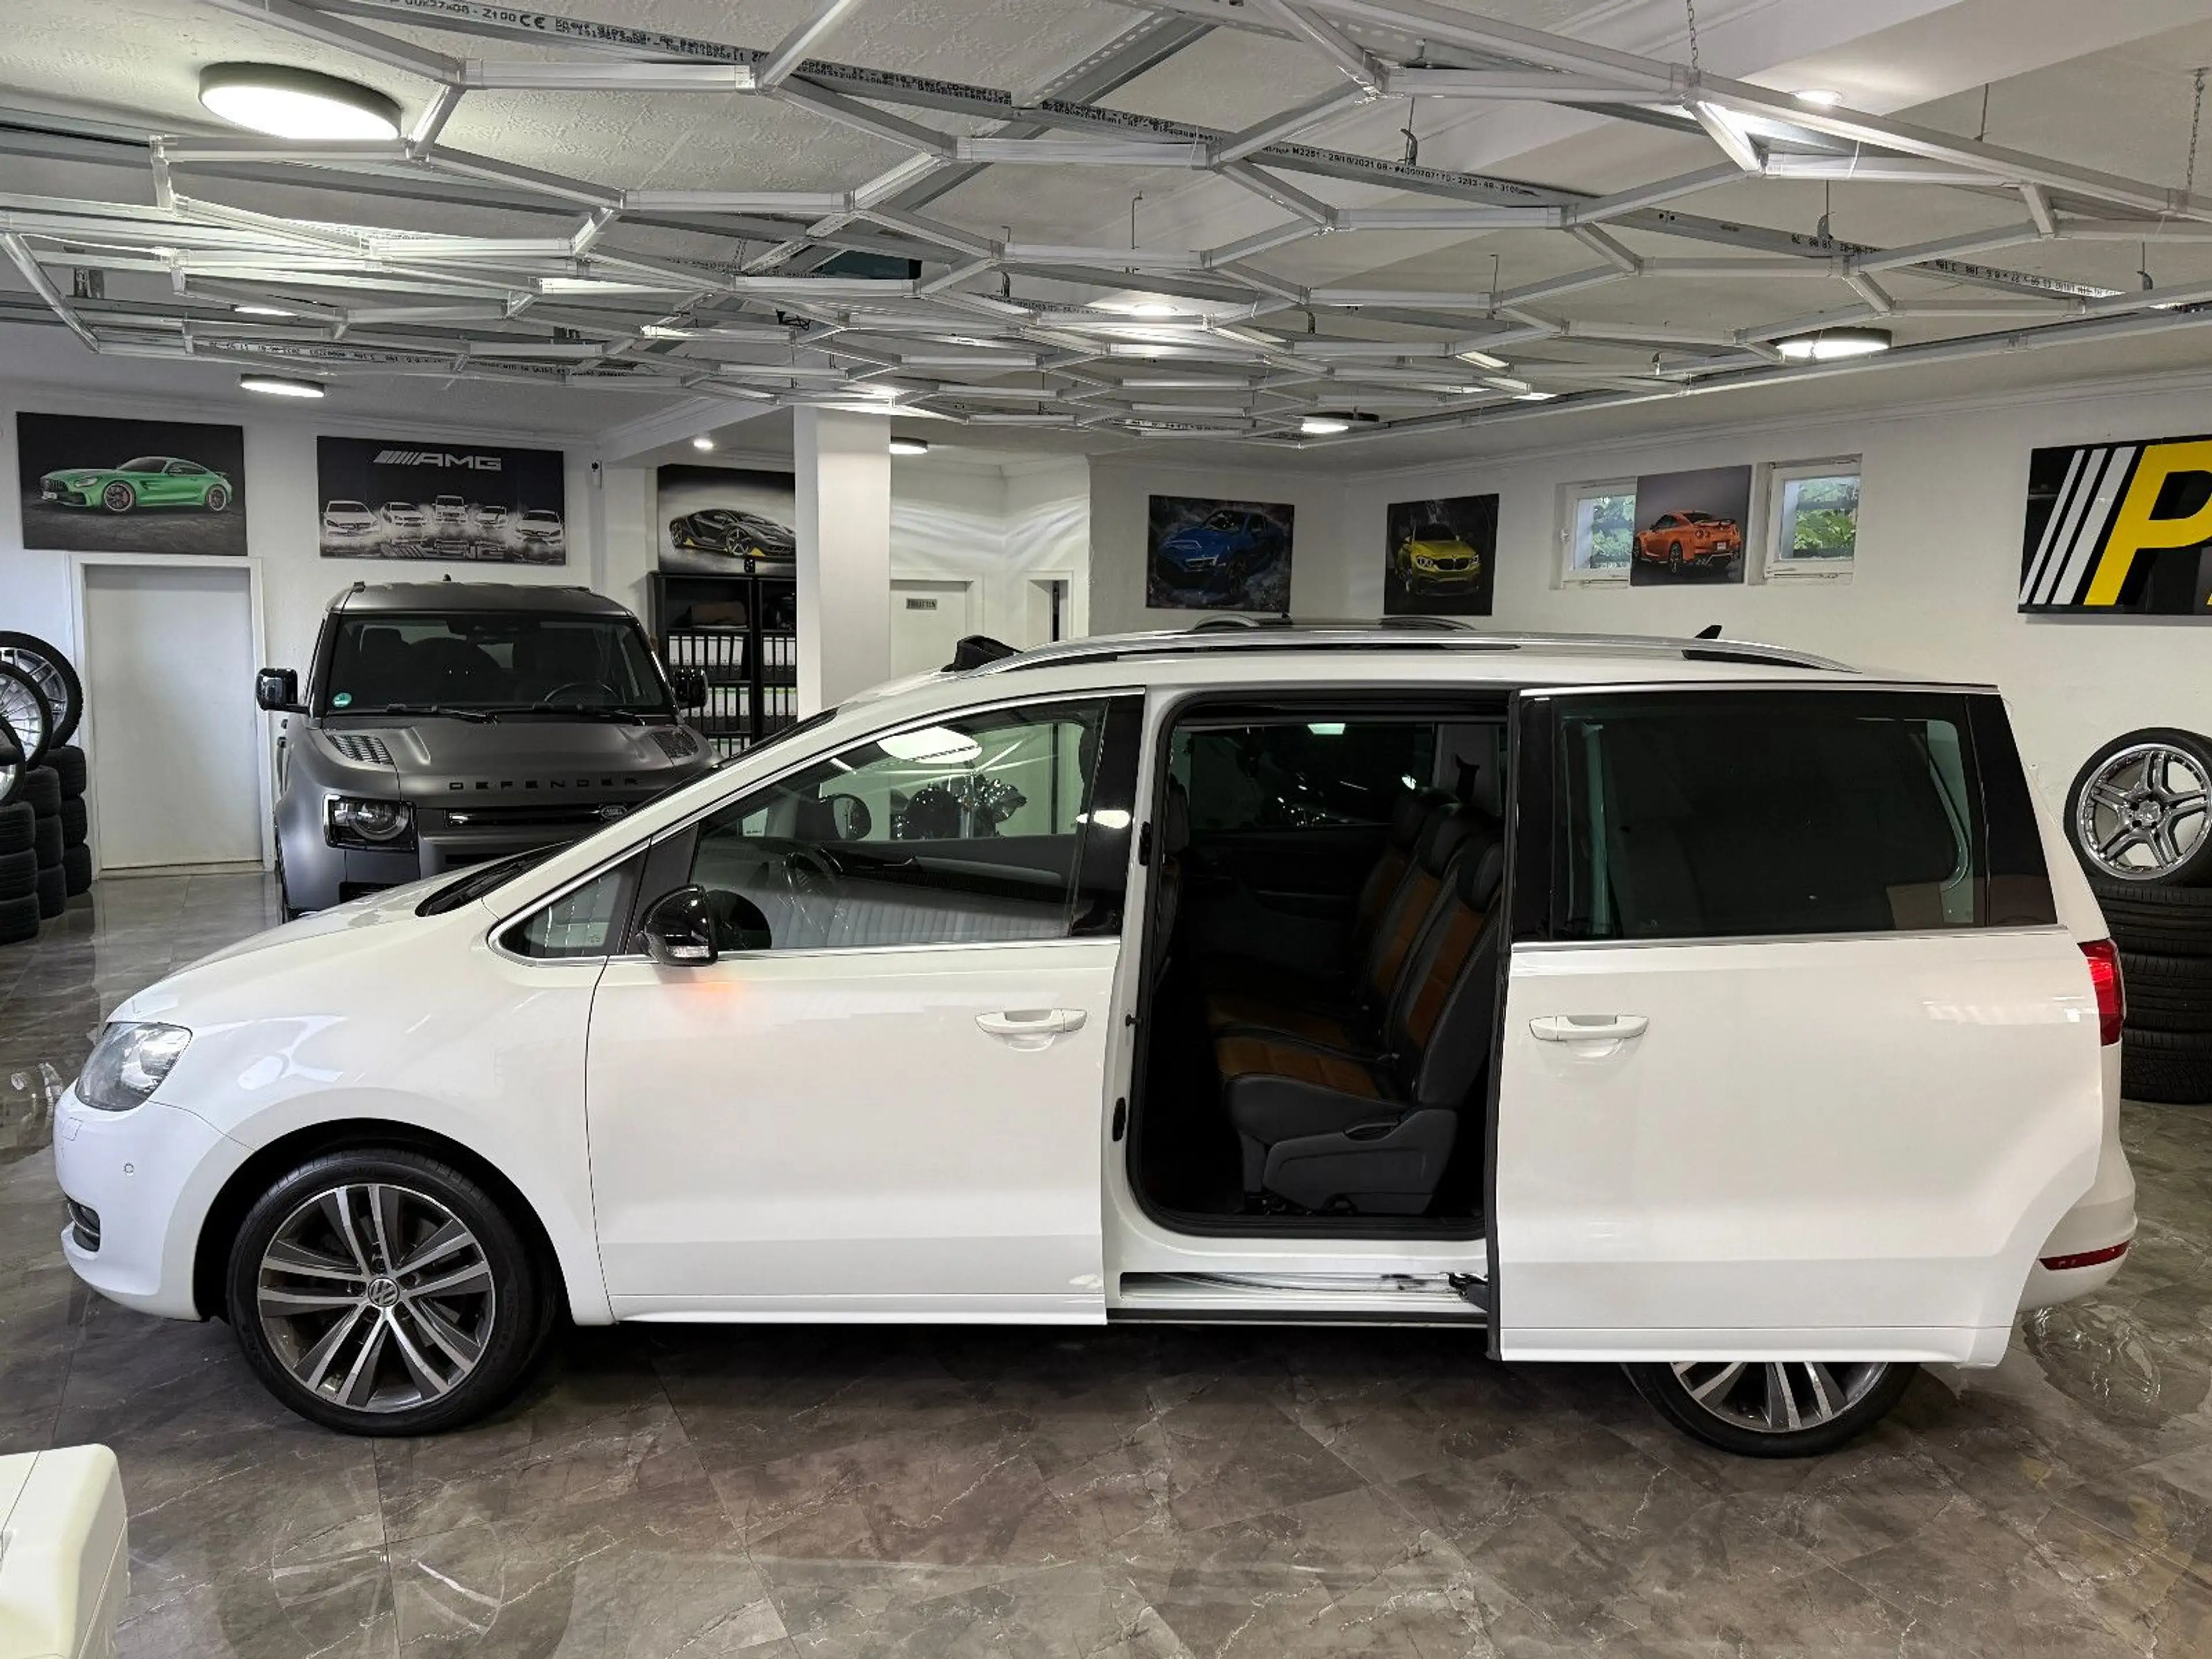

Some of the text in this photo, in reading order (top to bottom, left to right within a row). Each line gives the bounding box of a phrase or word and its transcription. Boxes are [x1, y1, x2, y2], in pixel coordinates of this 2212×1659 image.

[412, 452, 501, 471] AMG
[2083, 440, 2212, 605] P
[449, 778, 638, 790] DEFENDER
